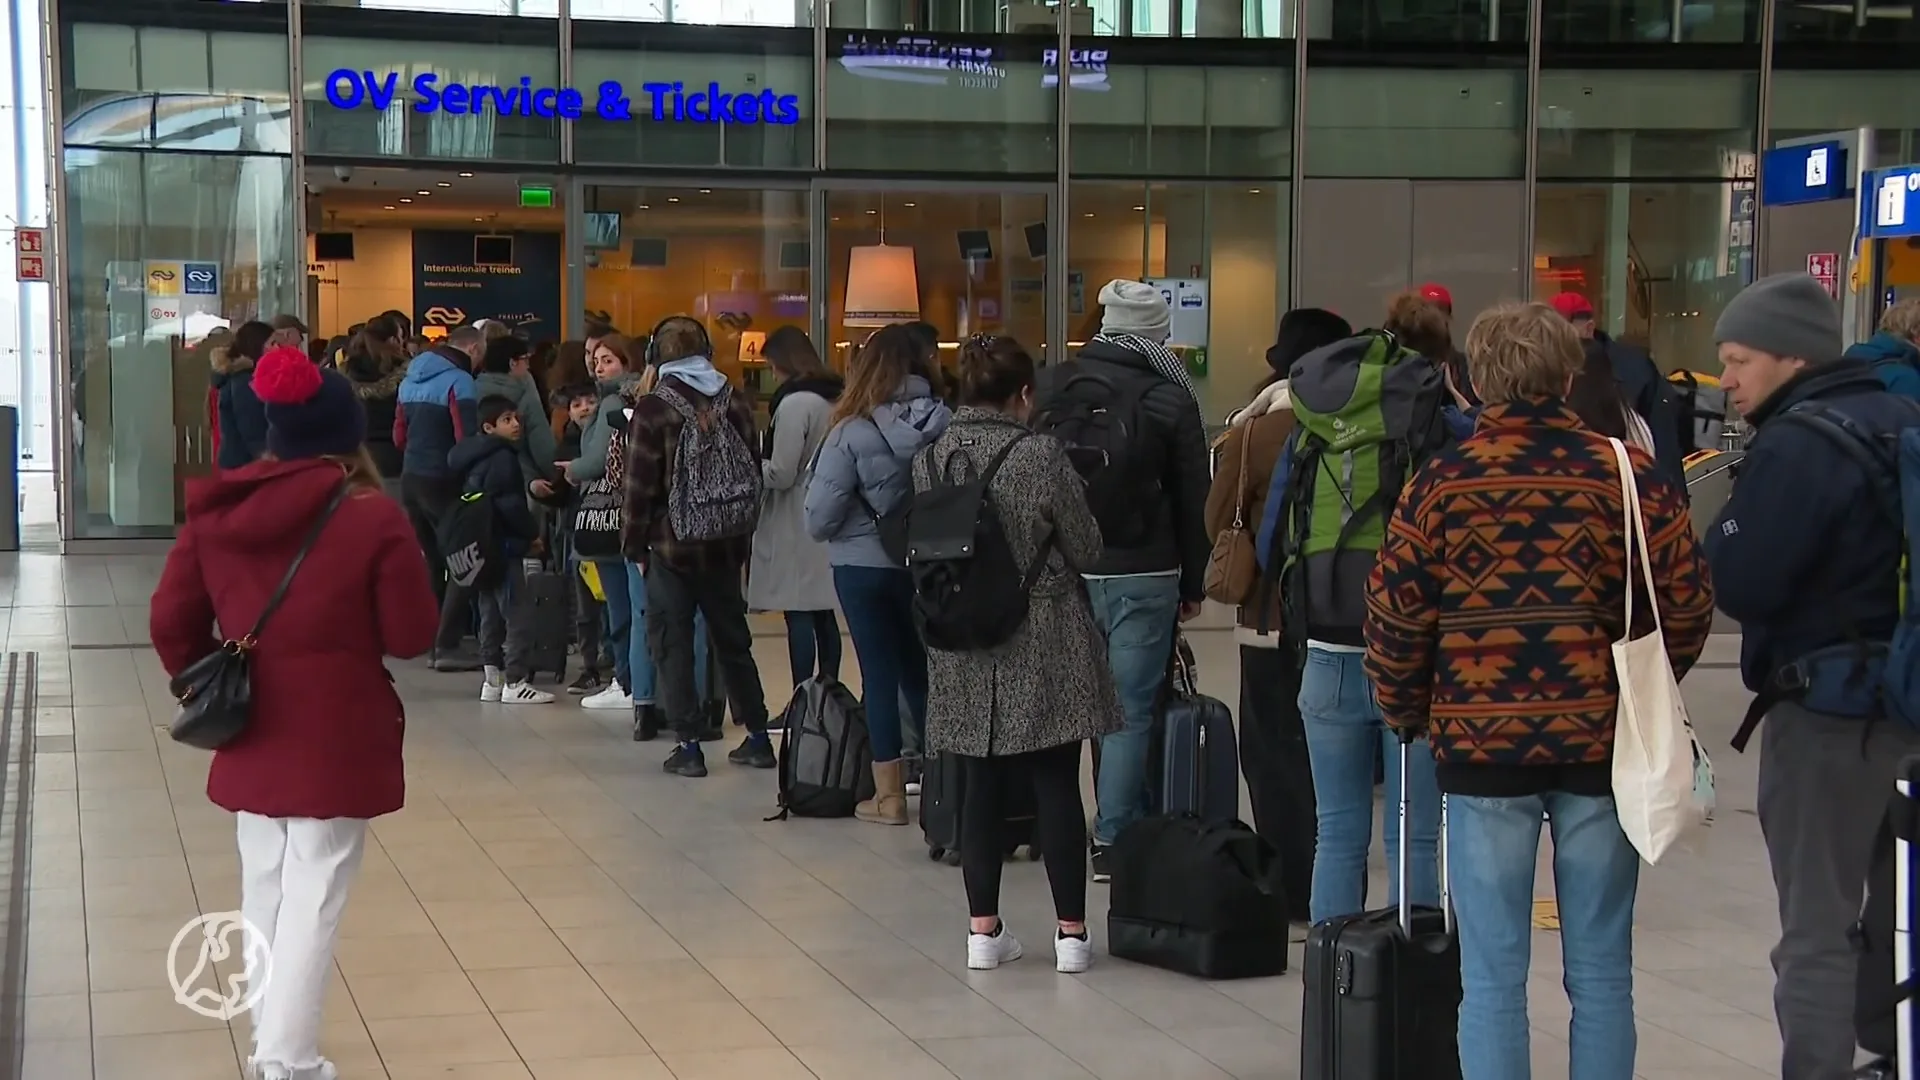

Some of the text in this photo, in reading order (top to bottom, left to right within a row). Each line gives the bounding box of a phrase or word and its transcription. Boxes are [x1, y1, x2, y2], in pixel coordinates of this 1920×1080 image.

[325, 68, 799, 125] OV Service & Tickets
[1908, 172, 1920, 192] O
[423, 263, 521, 275] Internationale treinen
[746, 341, 757, 356] 4
[446, 542, 480, 577] NIKE
